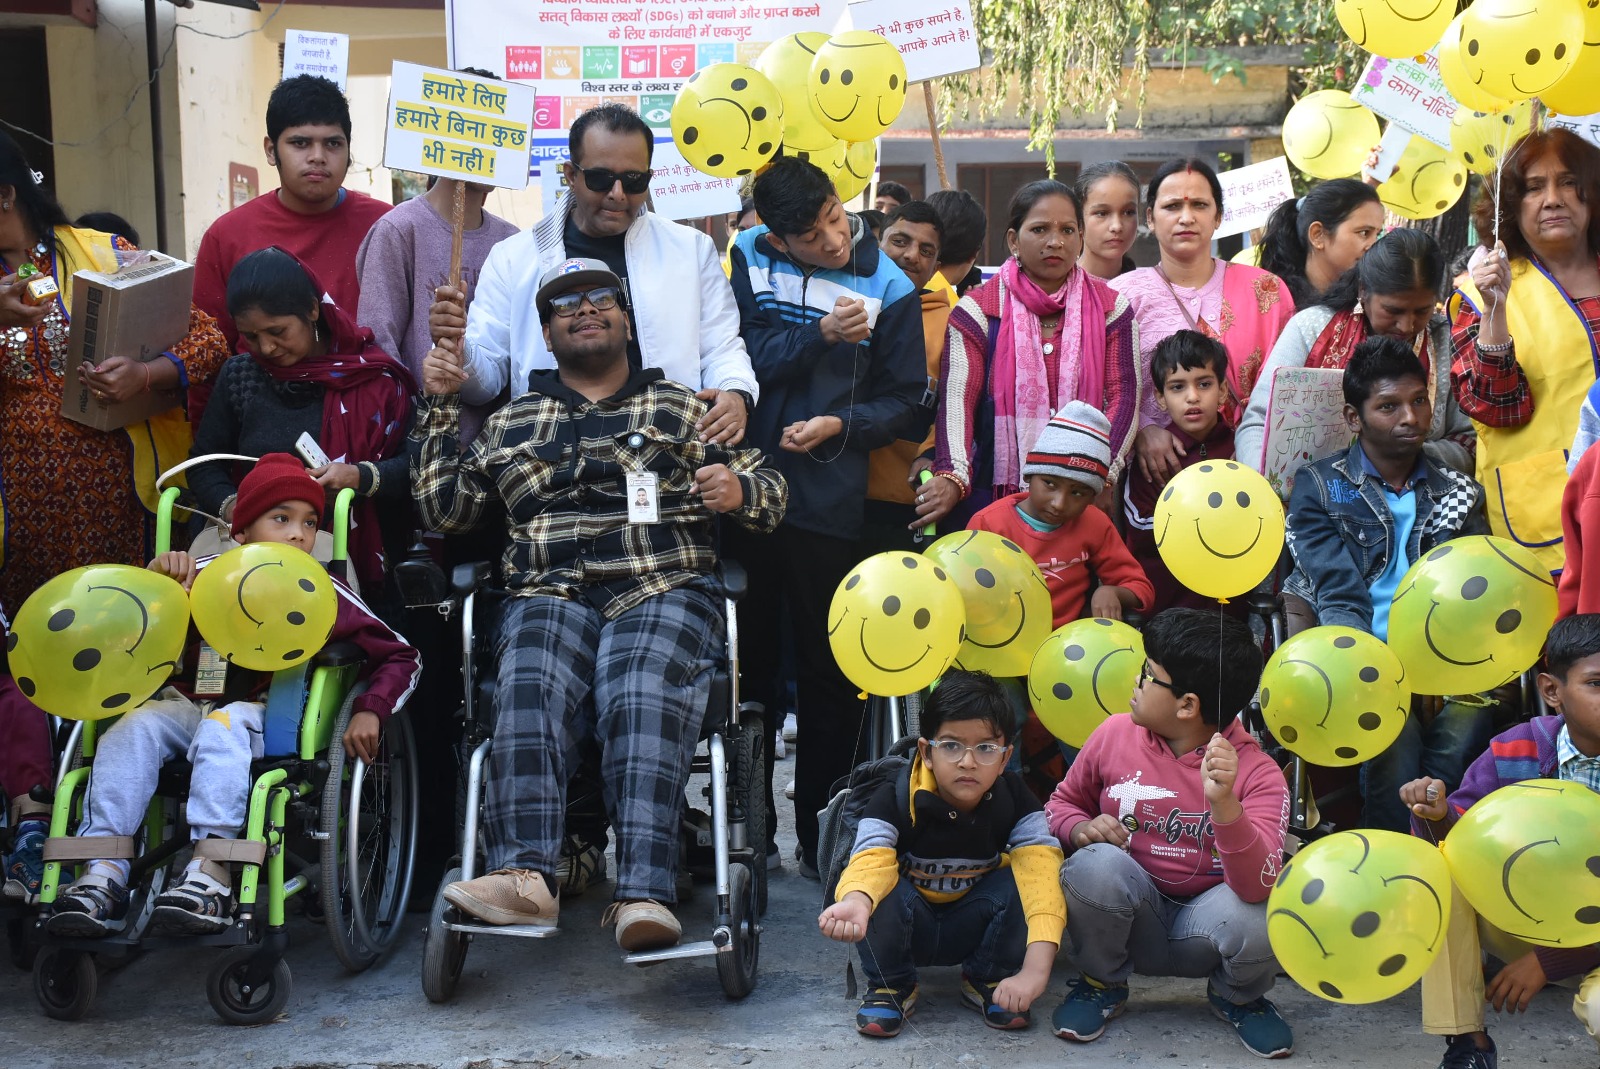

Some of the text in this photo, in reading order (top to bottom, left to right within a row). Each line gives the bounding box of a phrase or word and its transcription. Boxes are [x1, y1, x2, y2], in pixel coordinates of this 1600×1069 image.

[539, 3, 820, 26] सतत् विकास लक्ष्यों (SDGs) को बचाने और प्राप्त करने
[889, 20, 901, 34] भी
[904, 19, 924, 34] कुछ
[927, 10, 951, 26] सपने
[608, 23, 752, 41] के लिए कार्यवाही में एकजुट
[898, 37, 928, 54] आपके
[931, 30, 956, 47] अपने
[422, 78, 508, 113] हमारे लिए
[581, 81, 606, 92] विश्व
[609, 82, 629, 92] स्तर
[632, 81, 643, 92] के
[646, 82, 670, 92] लक्ष्य
[395, 106, 527, 147] हमारे बिना कुछ
[423, 137, 446, 164] भी
[450, 146, 485, 172] नही
[672, 164, 682, 175] भी
[654, 187, 666, 197] हम
[668, 184, 677, 194] भी
[680, 180, 702, 193] आपके
